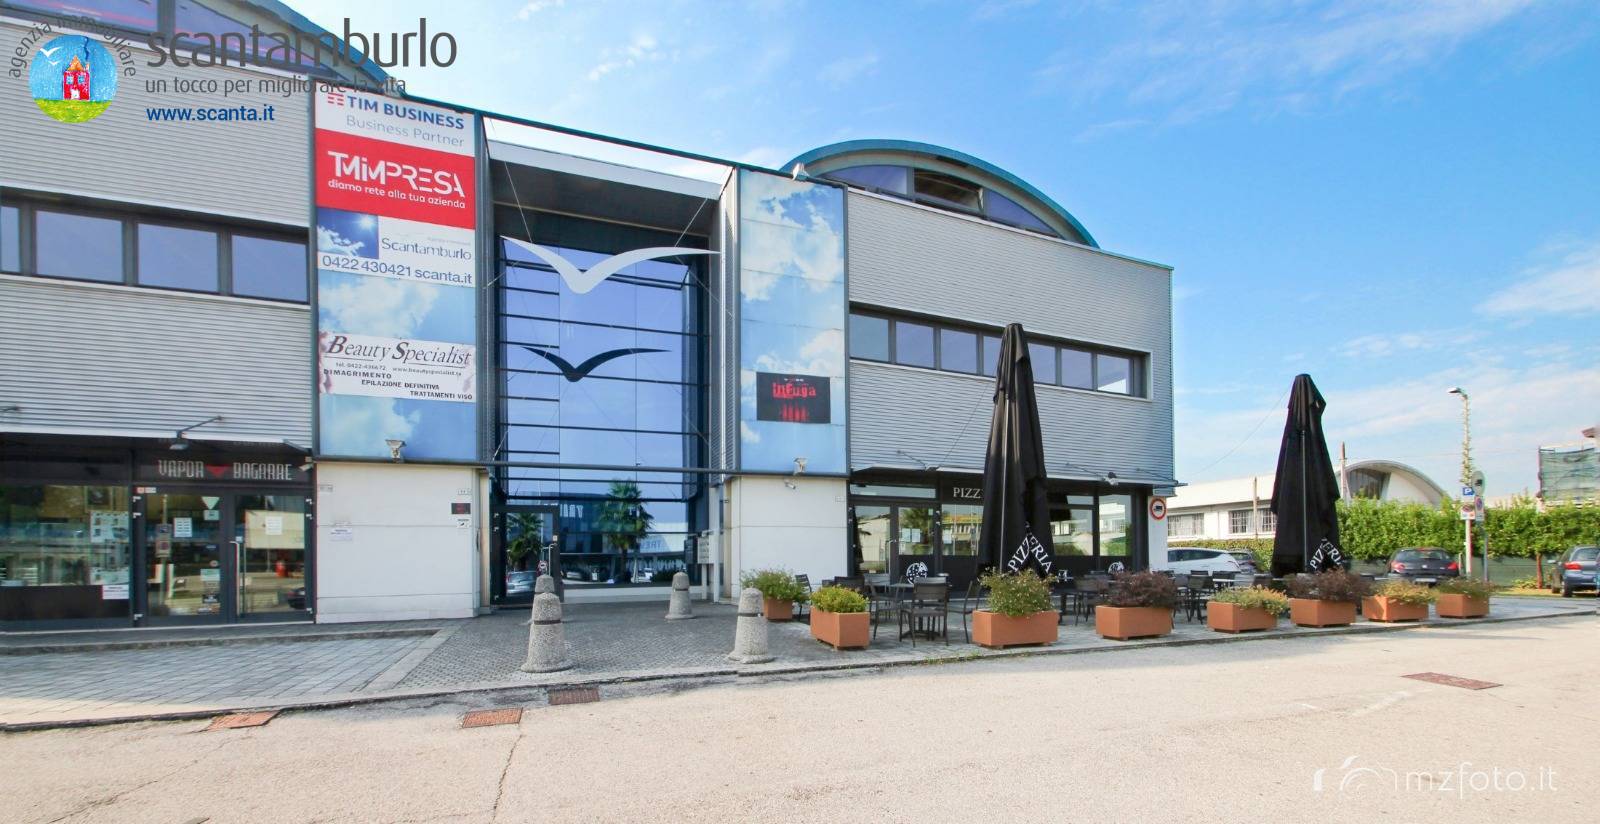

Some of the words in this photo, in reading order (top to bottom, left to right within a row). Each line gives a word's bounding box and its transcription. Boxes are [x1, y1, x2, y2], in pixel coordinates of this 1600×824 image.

[347, 95, 379, 113] TIM
[384, 103, 465, 130] BUSINESS
[346, 114, 409, 138] Business
[413, 128, 465, 148] Partner
[328, 179, 362, 193] diamo
[365, 185, 385, 197] rete
[388, 187, 407, 200] alla
[409, 193, 426, 203] tua
[428, 195, 466, 209] azienda
[381, 238, 472, 260] Scantamburlo
[322, 255, 360, 270] 0422
[361, 260, 412, 277] 430421
[415, 268, 473, 284] scanta.it
[328, 335, 392, 361] Beauty
[392, 341, 472, 365] Specialist
[323, 368, 392, 379] DIMAGRIMENTO
[361, 379, 402, 388] EPILAZIONE
[404, 382, 440, 391] DEFINITIVA
[410, 390, 456, 399] TRATTAMENTI
[953, 487, 984, 499] PIZZ
